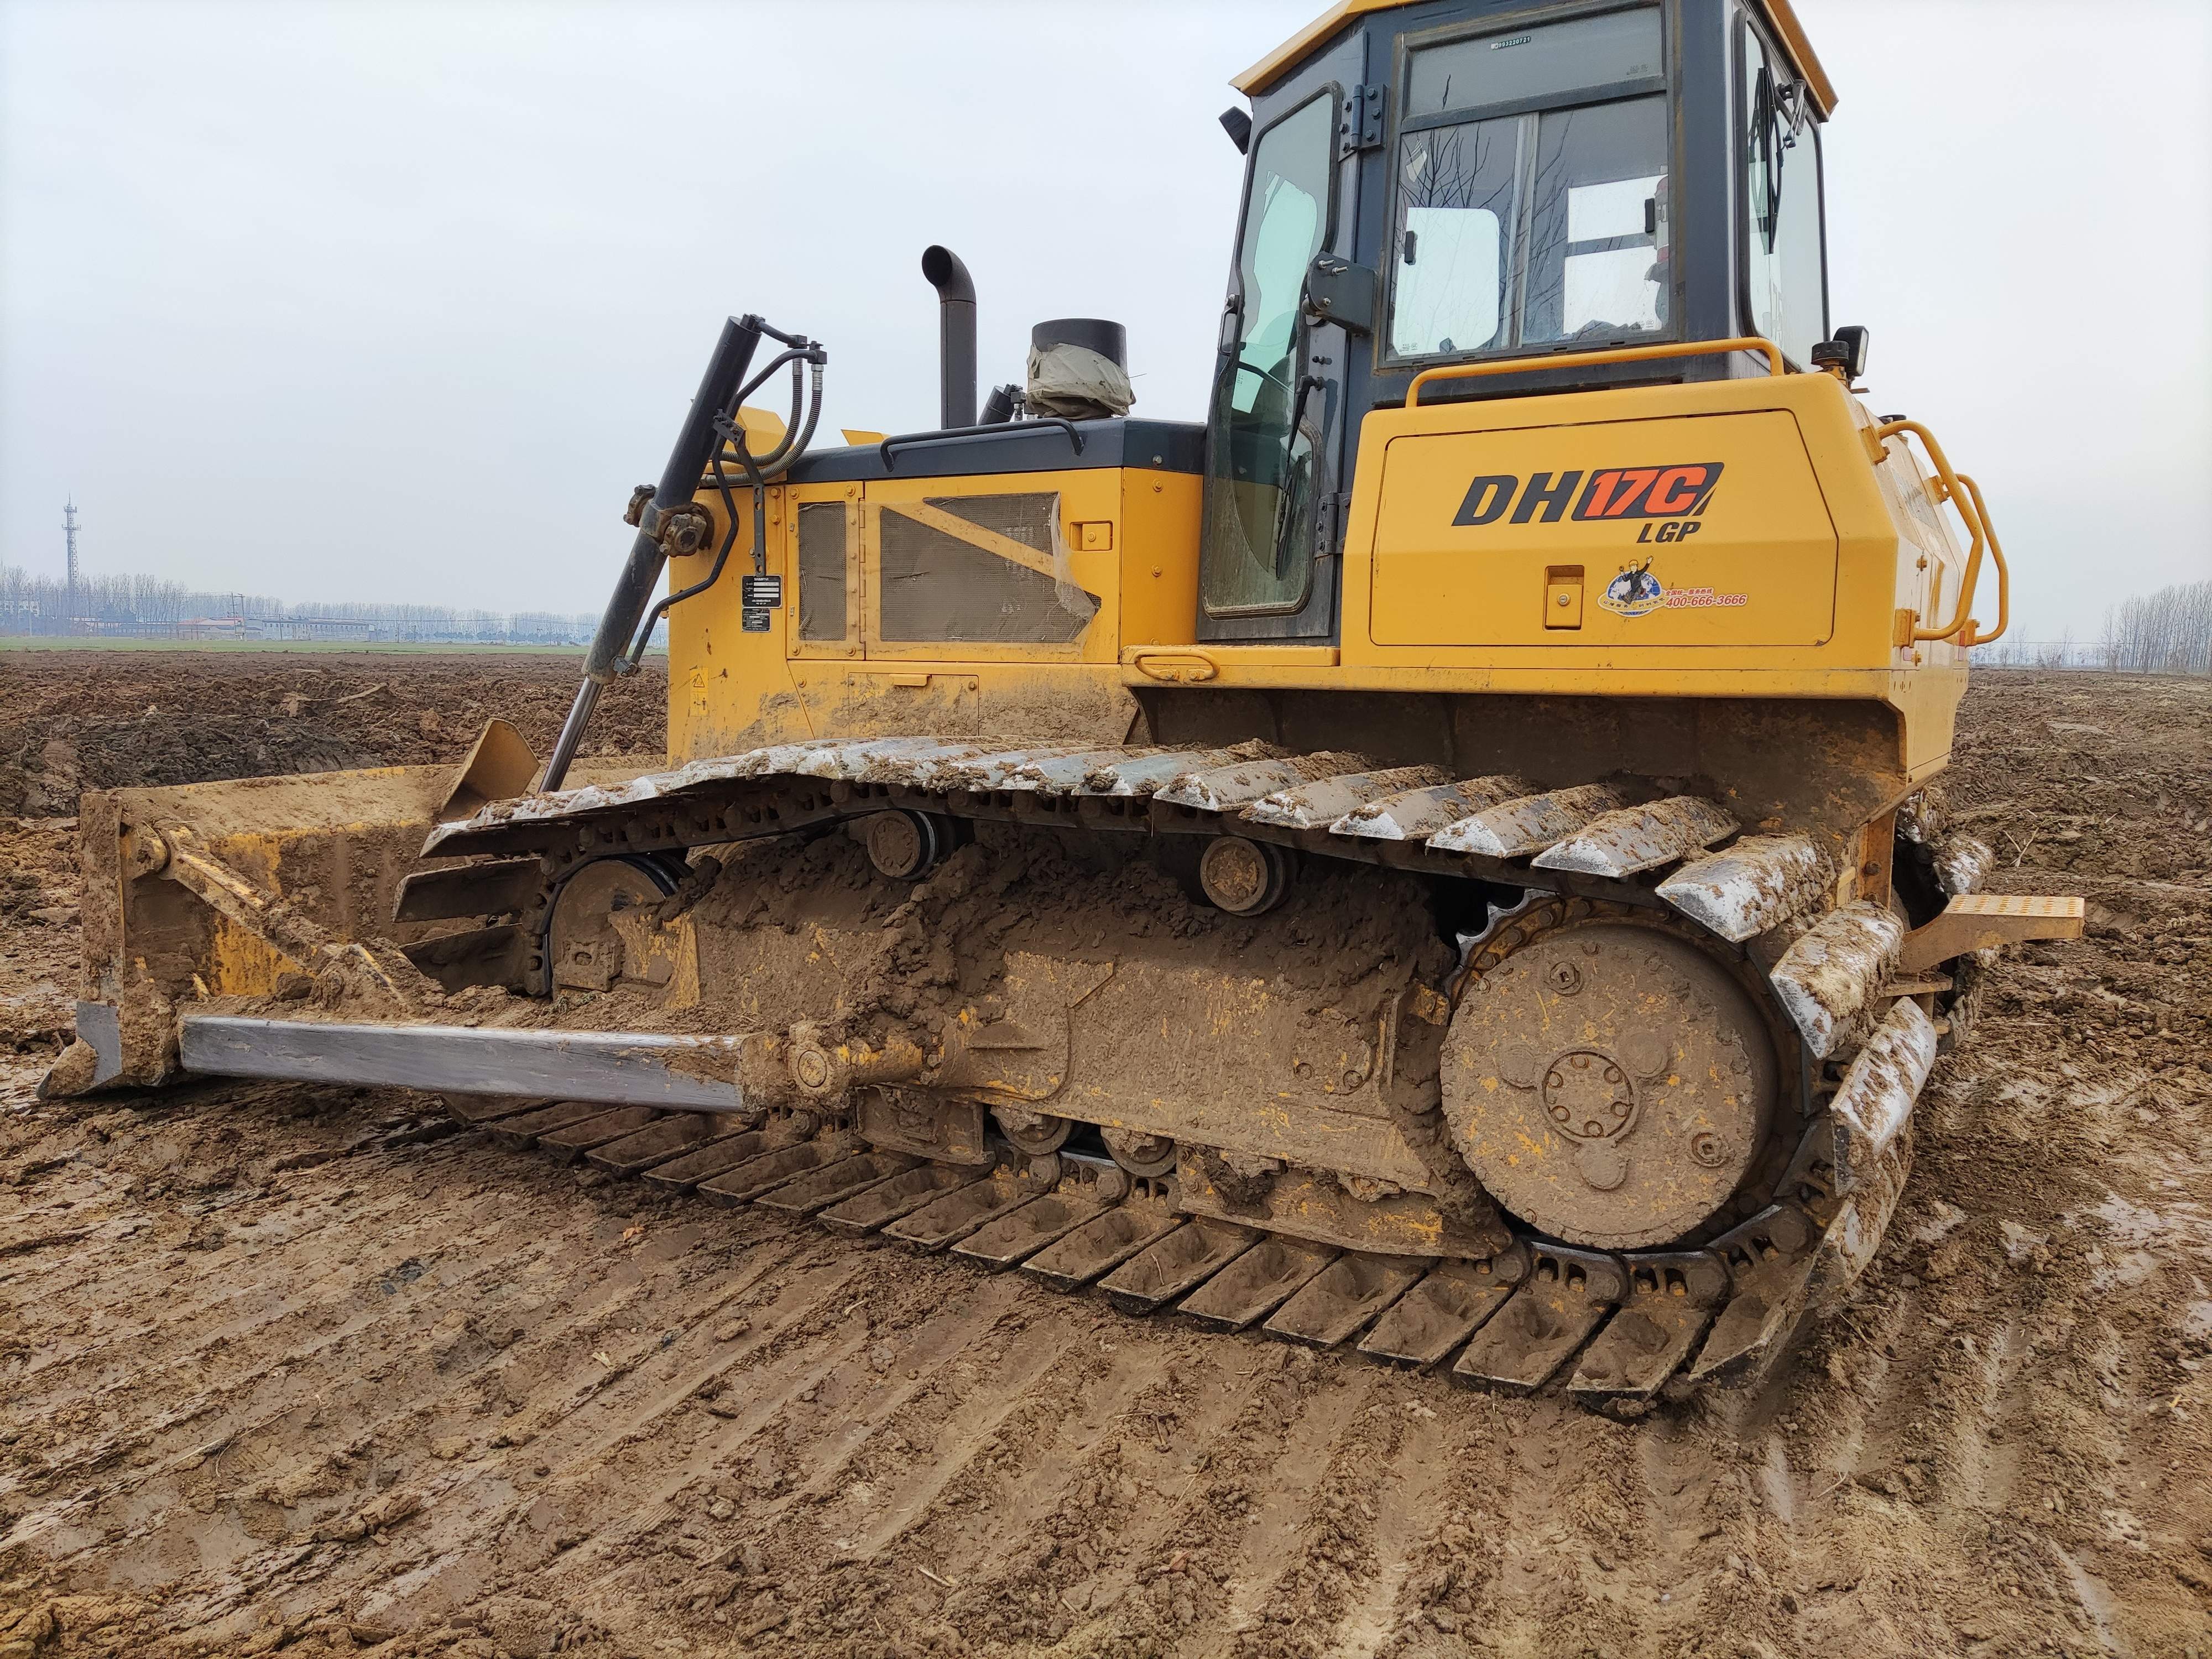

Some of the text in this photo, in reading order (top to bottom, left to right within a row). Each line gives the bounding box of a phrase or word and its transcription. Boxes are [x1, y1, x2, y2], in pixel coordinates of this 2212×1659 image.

[1452, 466, 1711, 526] DH17C
[1636, 521, 1702, 543] LGP
[1666, 588, 1713, 596] 全国统一服务热线
[1666, 594, 1746, 607] 400-666-3666
